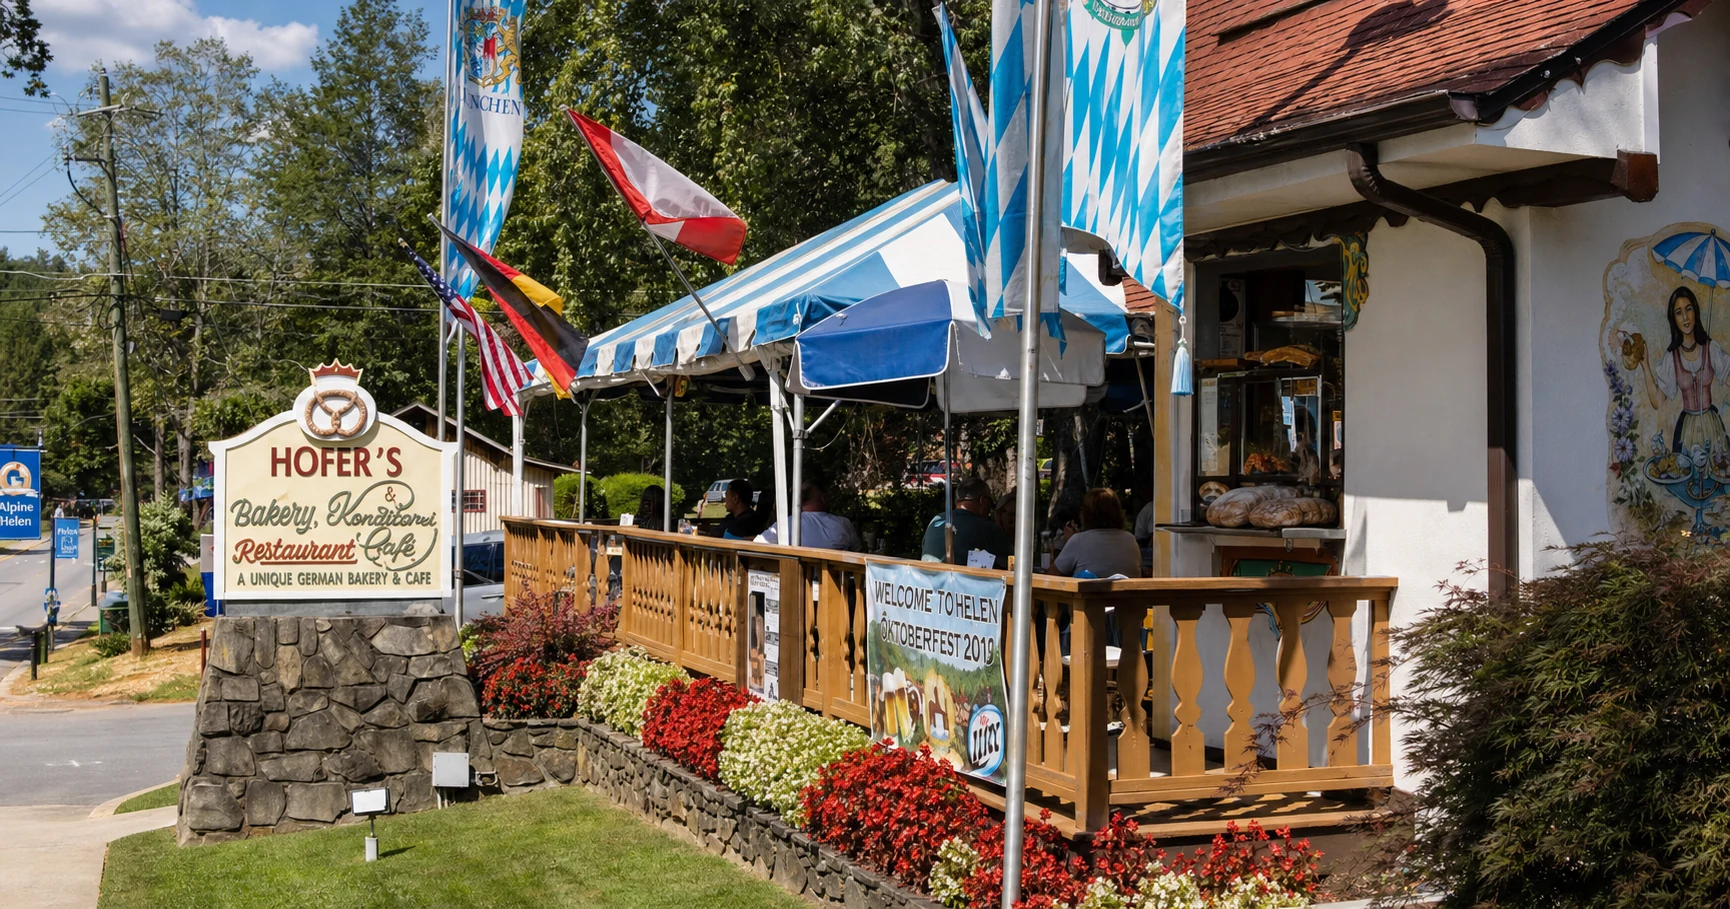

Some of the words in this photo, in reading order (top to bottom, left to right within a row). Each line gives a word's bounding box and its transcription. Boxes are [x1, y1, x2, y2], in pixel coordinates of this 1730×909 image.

[271, 446, 403, 478] HOFER'S
[230, 498, 319, 535] Bakery,
[326, 480, 437, 527] Konditorei
[385, 486, 396, 502] &
[0, 501, 34, 515] Alpine
[0, 515, 32, 527] Helen
[232, 537, 358, 564] Restaurant
[237, 572, 246, 586] A
[250, 572, 293, 587] UNIQUE
[297, 572, 343, 586] GERMAN
[348, 572, 388, 586] BAKERY
[392, 572, 401, 586] &
[405, 571, 431, 585] CAFE
[874, 580, 934, 613] WELCOME
[937, 589, 955, 617] TO
[955, 592, 998, 624] HELEN
[964, 632, 995, 665] 2019
